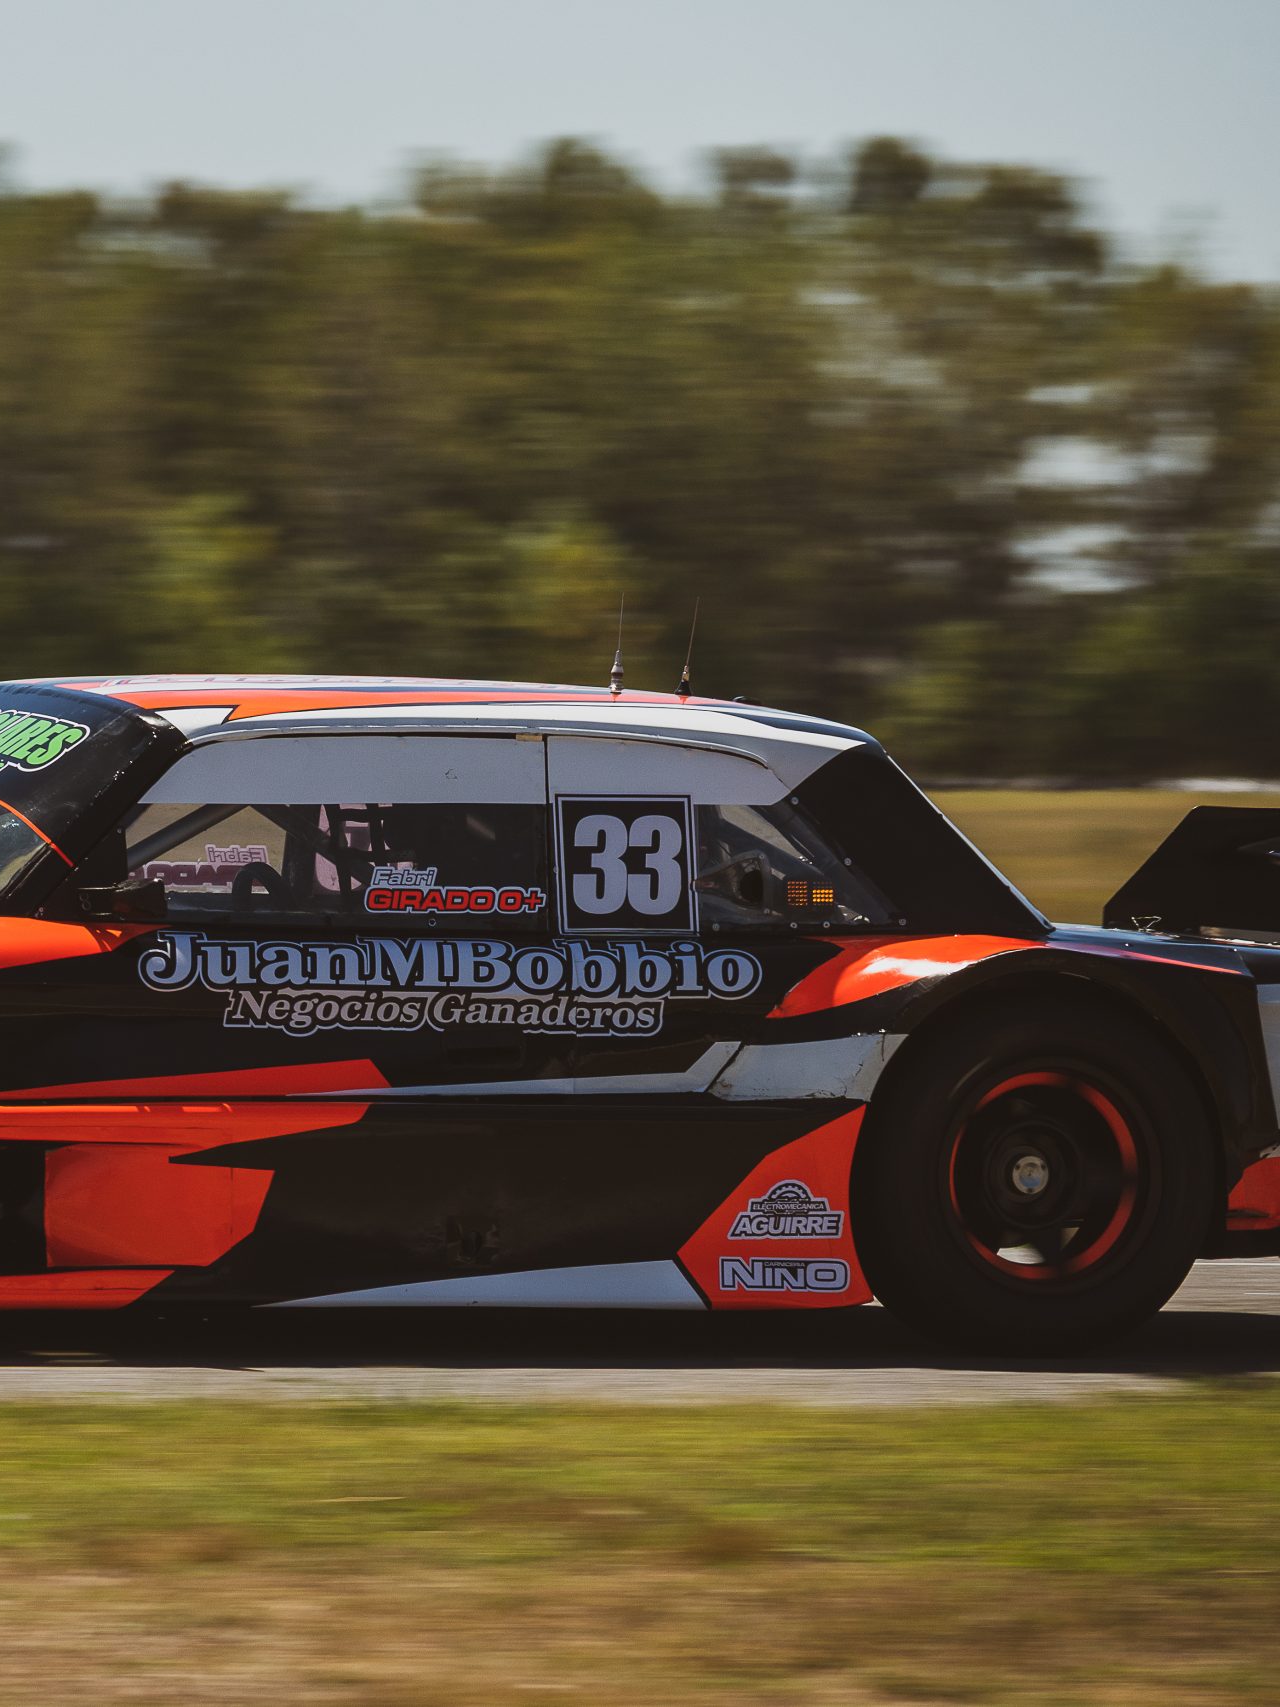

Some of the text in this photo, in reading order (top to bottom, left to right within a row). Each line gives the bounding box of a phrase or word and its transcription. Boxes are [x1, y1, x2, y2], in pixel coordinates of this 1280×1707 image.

[572, 814, 683, 916] 33
[373, 868, 435, 886] Fabri
[367, 888, 496, 911] GIRADO
[231, 990, 657, 1029] Negocios Ganaderos
[752, 1202, 825, 1212] ELECTROMECANICA
[735, 1216, 839, 1234] AGUIRRE
